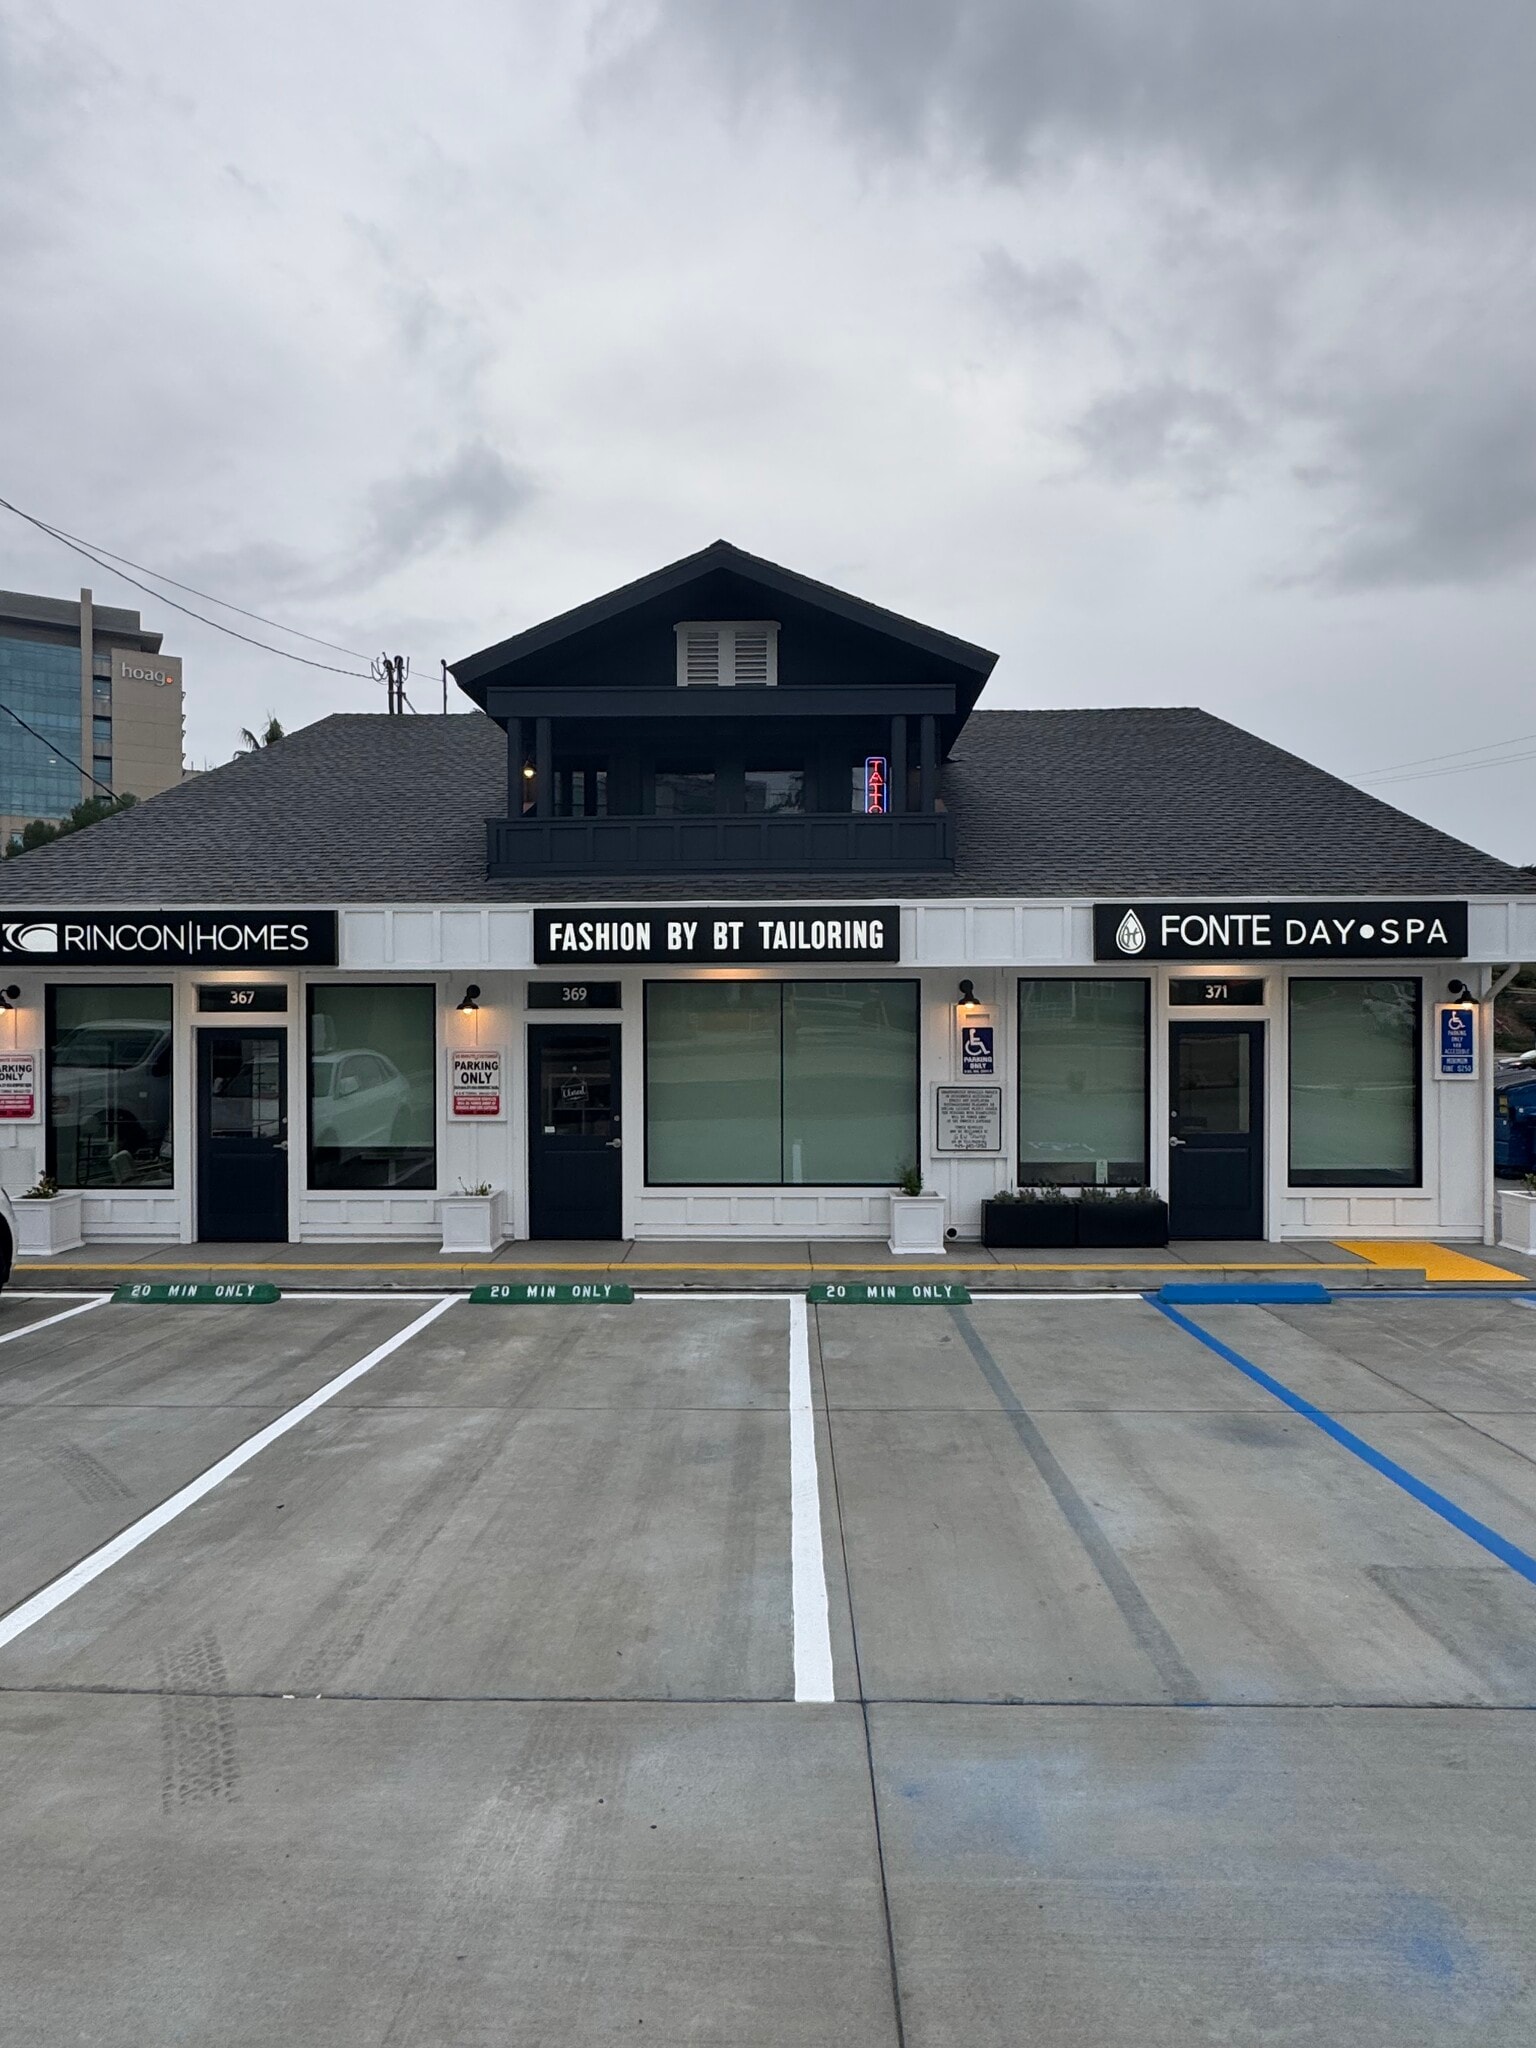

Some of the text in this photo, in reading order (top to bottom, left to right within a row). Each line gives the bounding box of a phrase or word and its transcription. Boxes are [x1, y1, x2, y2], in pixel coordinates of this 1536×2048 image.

[549, 920, 884, 951] FASHION BY BT TAILORING
[1161, 914, 1272, 946] FONTE
[229, 990, 256, 1005] 367
[562, 987, 588, 1001] 369
[1205, 985, 1228, 999] 371
[454, 1061, 499, 1071] PARKING
[460, 1072, 493, 1084] ONLY
[131, 1284, 255, 1297] 20 MIN ONLY
[490, 1285, 612, 1298] 20 MIN ONLY
[826, 1285, 952, 1298] 20 MIN ONLY
